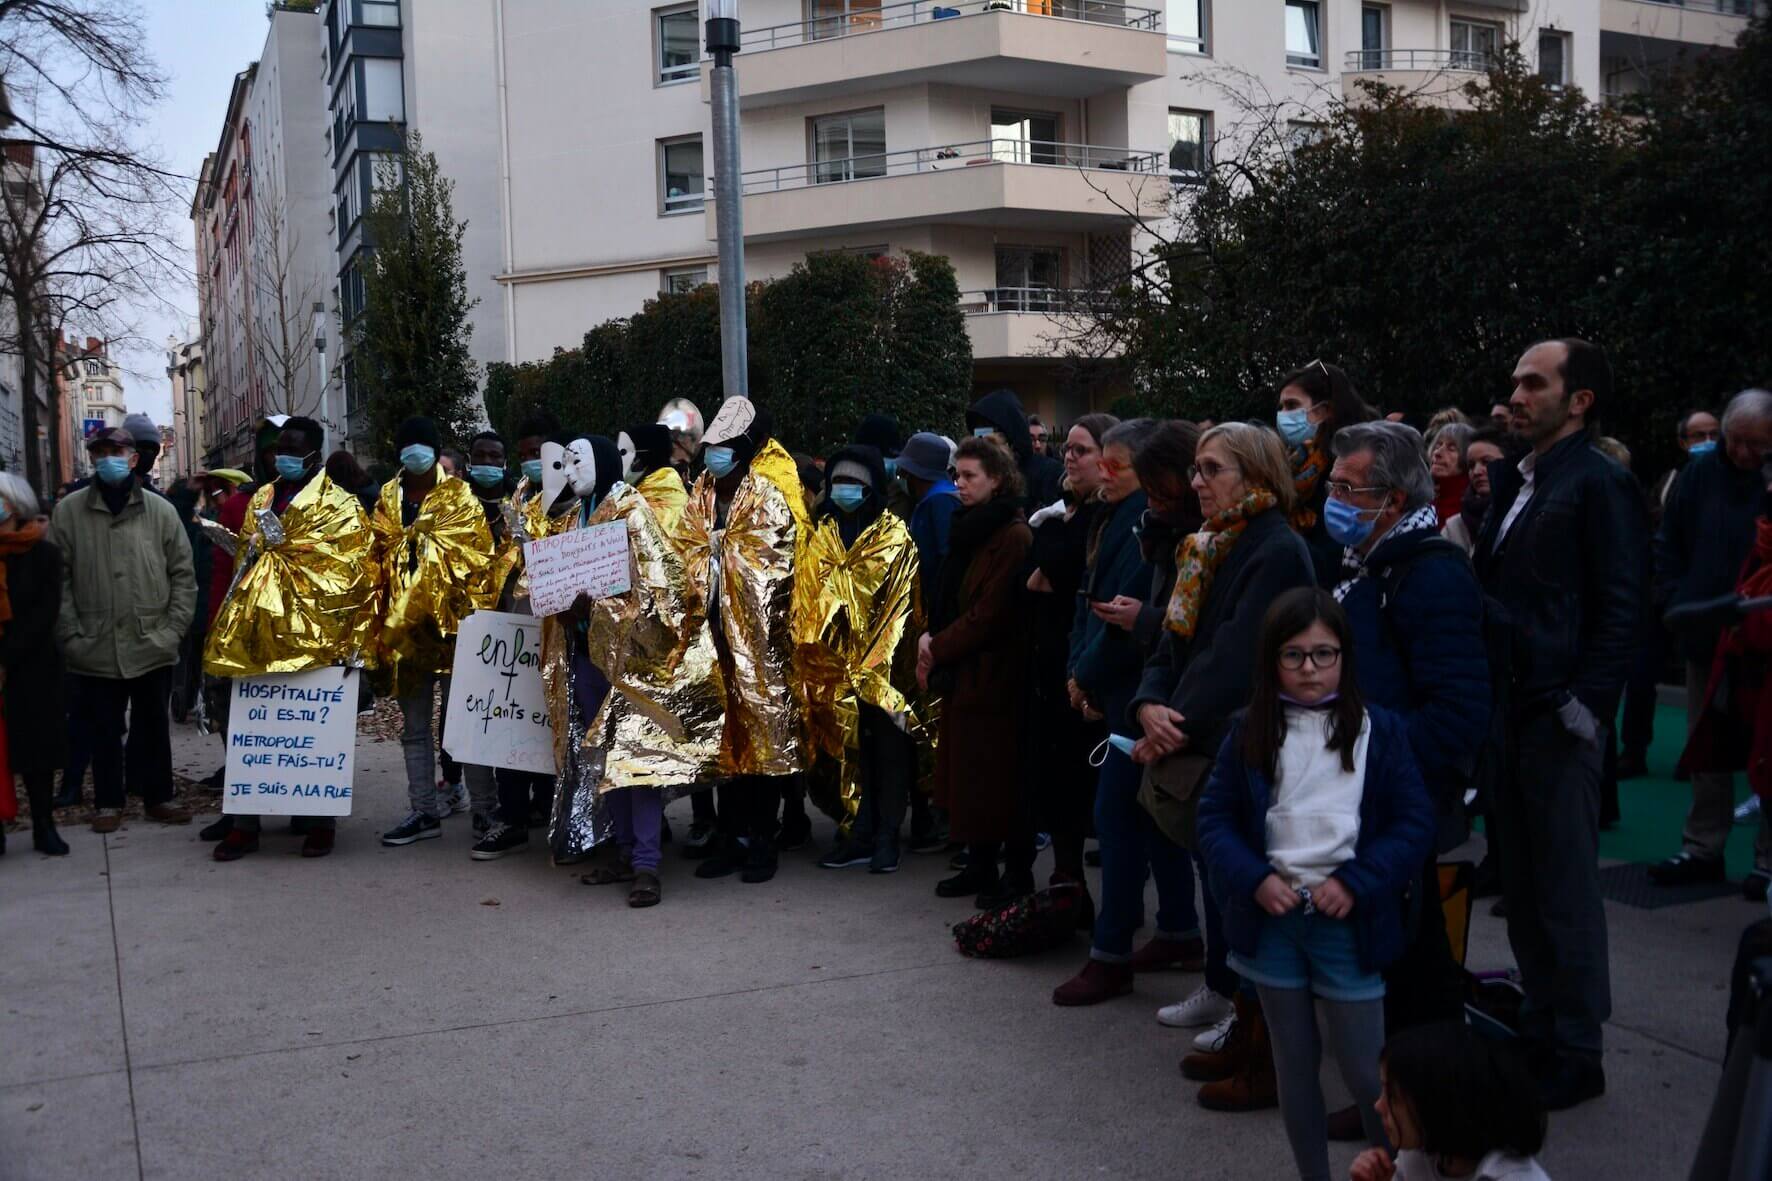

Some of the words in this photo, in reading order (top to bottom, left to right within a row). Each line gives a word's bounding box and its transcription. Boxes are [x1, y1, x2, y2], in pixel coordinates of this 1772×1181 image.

[248, 704, 267, 721] OÙ
[466, 688, 525, 735] enfants
[232, 734, 315, 749] METROPOLE
[242, 753, 272, 767] QUE
[230, 783, 252, 796] JE
[292, 784, 303, 796] A
[305, 783, 320, 797] LA
[324, 785, 352, 799] RUE
